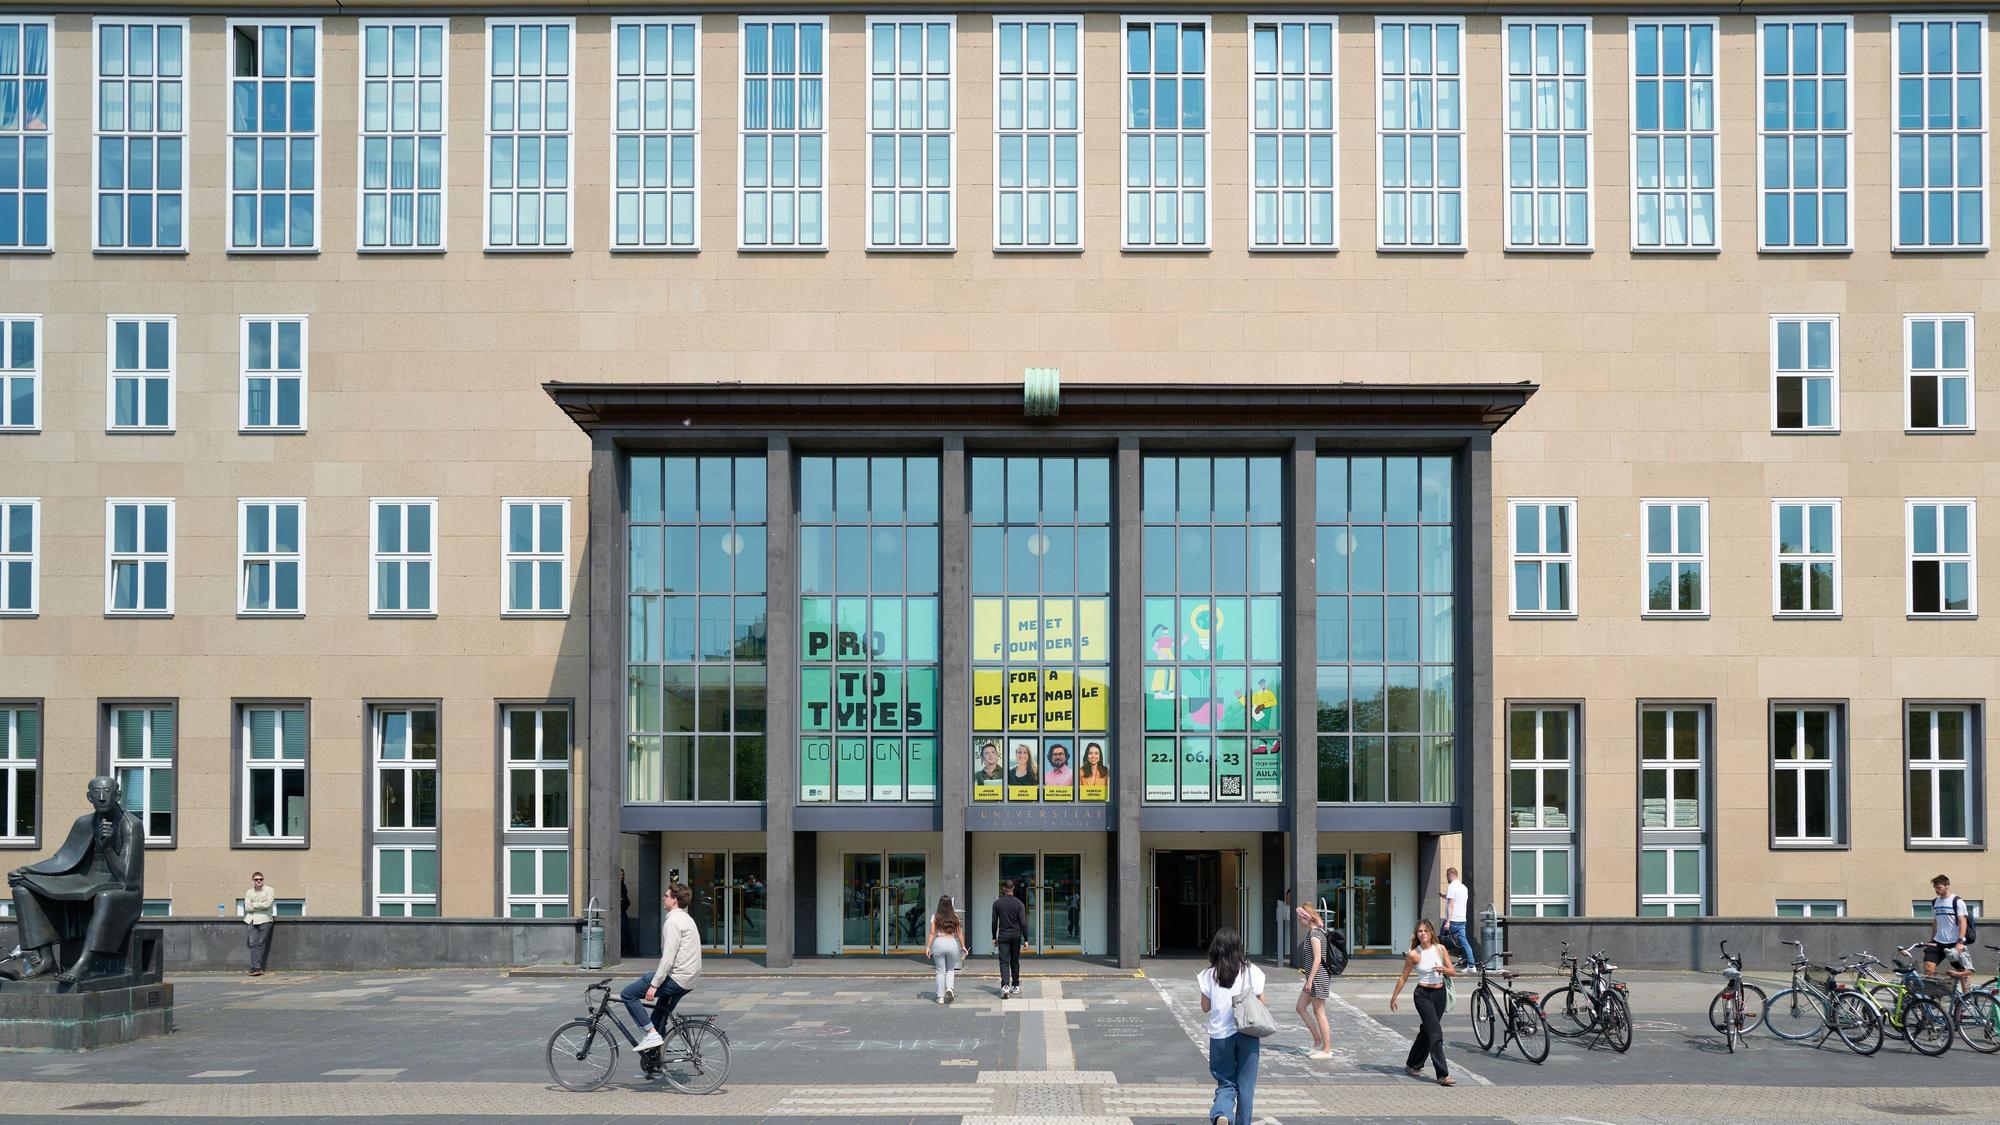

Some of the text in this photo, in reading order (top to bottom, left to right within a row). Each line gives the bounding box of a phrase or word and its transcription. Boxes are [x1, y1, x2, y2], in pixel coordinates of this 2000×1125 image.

[1018, 618, 1063, 632] MEET
[809, 631, 886, 656] PRO
[993, 636, 1090, 654] FOUNDERS
[839, 672, 886, 697] TO
[1010, 670, 1059, 684] FOR A
[975, 687, 1099, 707] SUSTAINABLE
[808, 702, 923, 727] TYPES
[1010, 710, 1073, 725] FUTURE
[808, 743, 922, 761] COLOGNE
[1151, 751, 1240, 766] 22. 06. 23
